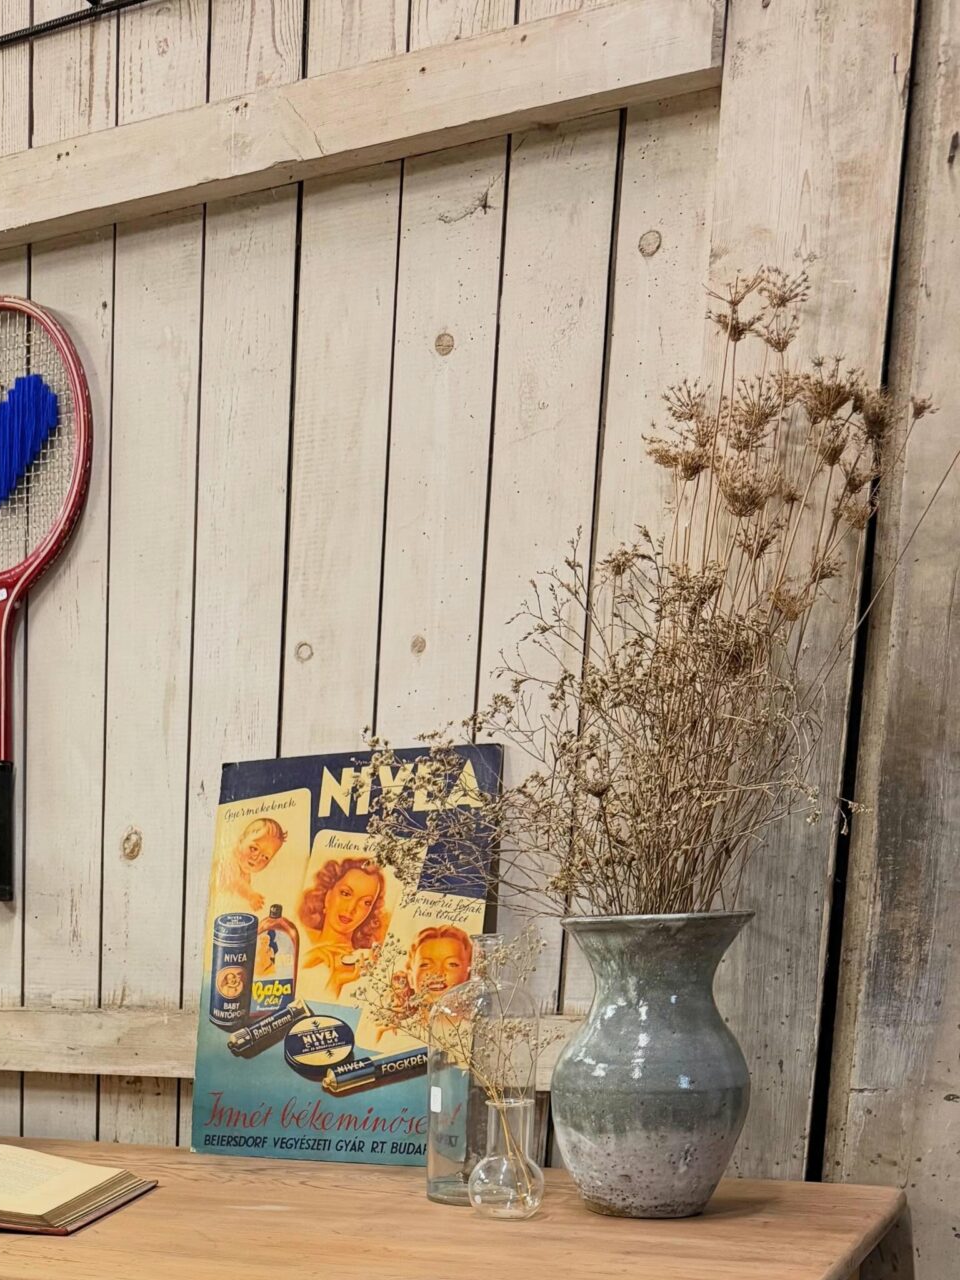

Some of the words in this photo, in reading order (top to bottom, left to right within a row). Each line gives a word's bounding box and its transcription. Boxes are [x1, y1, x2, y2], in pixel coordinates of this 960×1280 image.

[318, 758, 483, 818] NIVEA
[324, 834, 360, 851] Minden
[224, 953, 248, 963] NIVEA
[252, 980, 292, 1003] Baba
[223, 1002, 240, 1010] BABY
[253, 1024, 272, 1040] Baby
[302, 1029, 339, 1044] NIVEA
[336, 1060, 366, 1074] NIVEA
[204, 1134, 268, 1148] BEIERSDORF
[273, 1135, 331, 1152] VEGYÉSZETI
[335, 1136, 366, 1153] GYÁR
